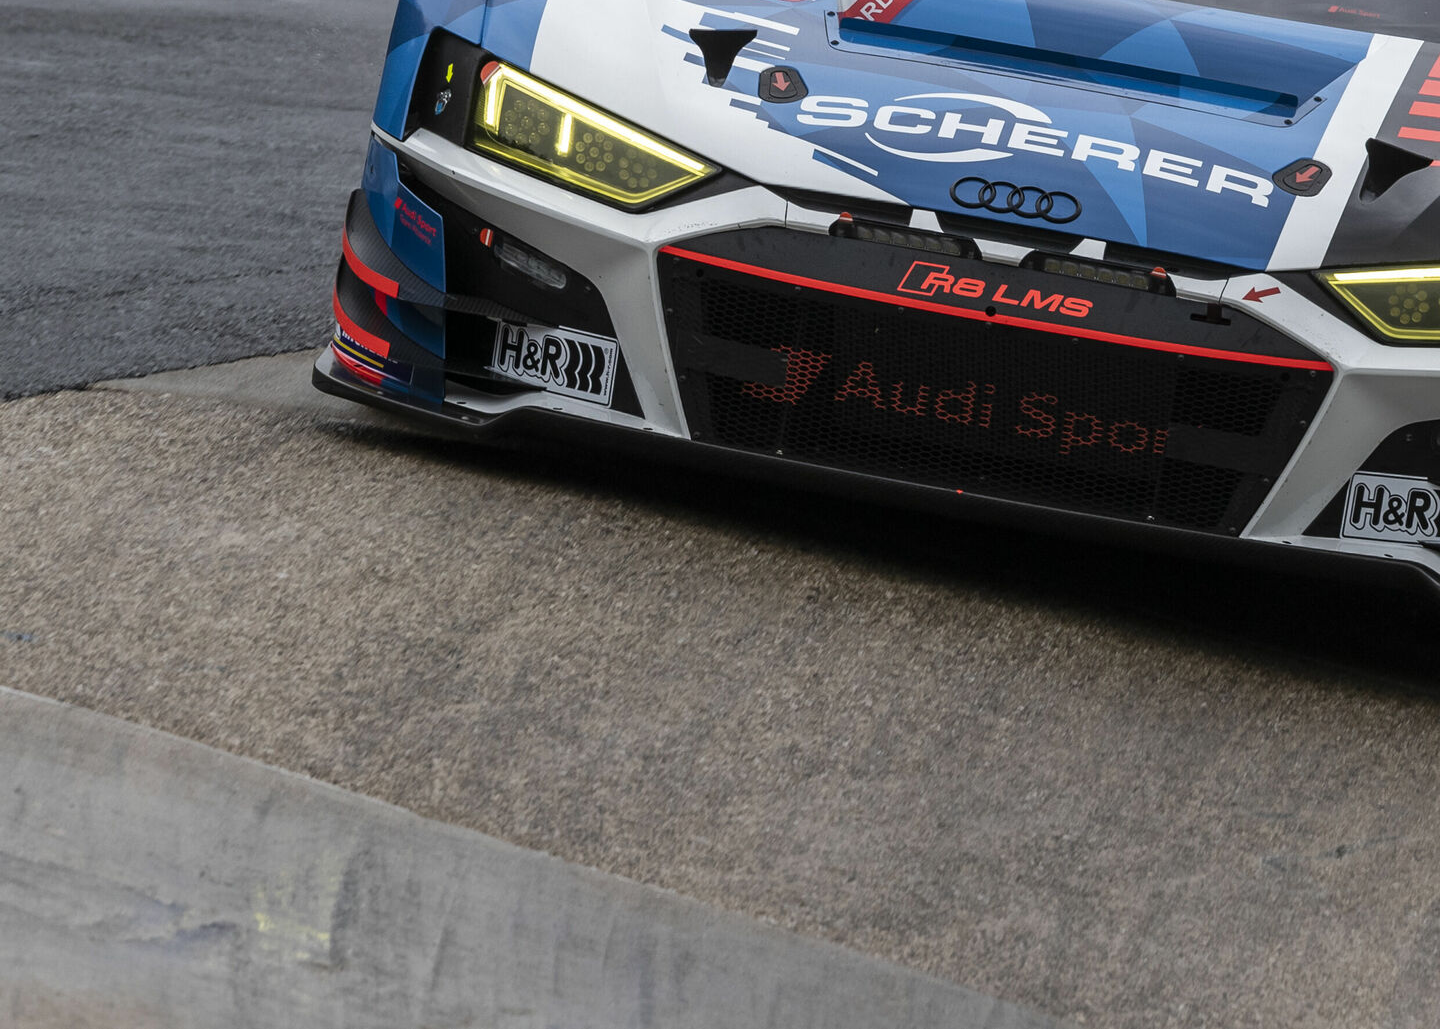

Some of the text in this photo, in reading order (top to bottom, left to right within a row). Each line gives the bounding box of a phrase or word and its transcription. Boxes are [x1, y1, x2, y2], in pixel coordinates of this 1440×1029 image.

[796, 95, 1275, 208] SCHERER
[992, 284, 1094, 318] LMS
[500, 325, 564, 381] H&R
[834, 360, 996, 429] Audi
[1352, 484, 1433, 531] H&R
